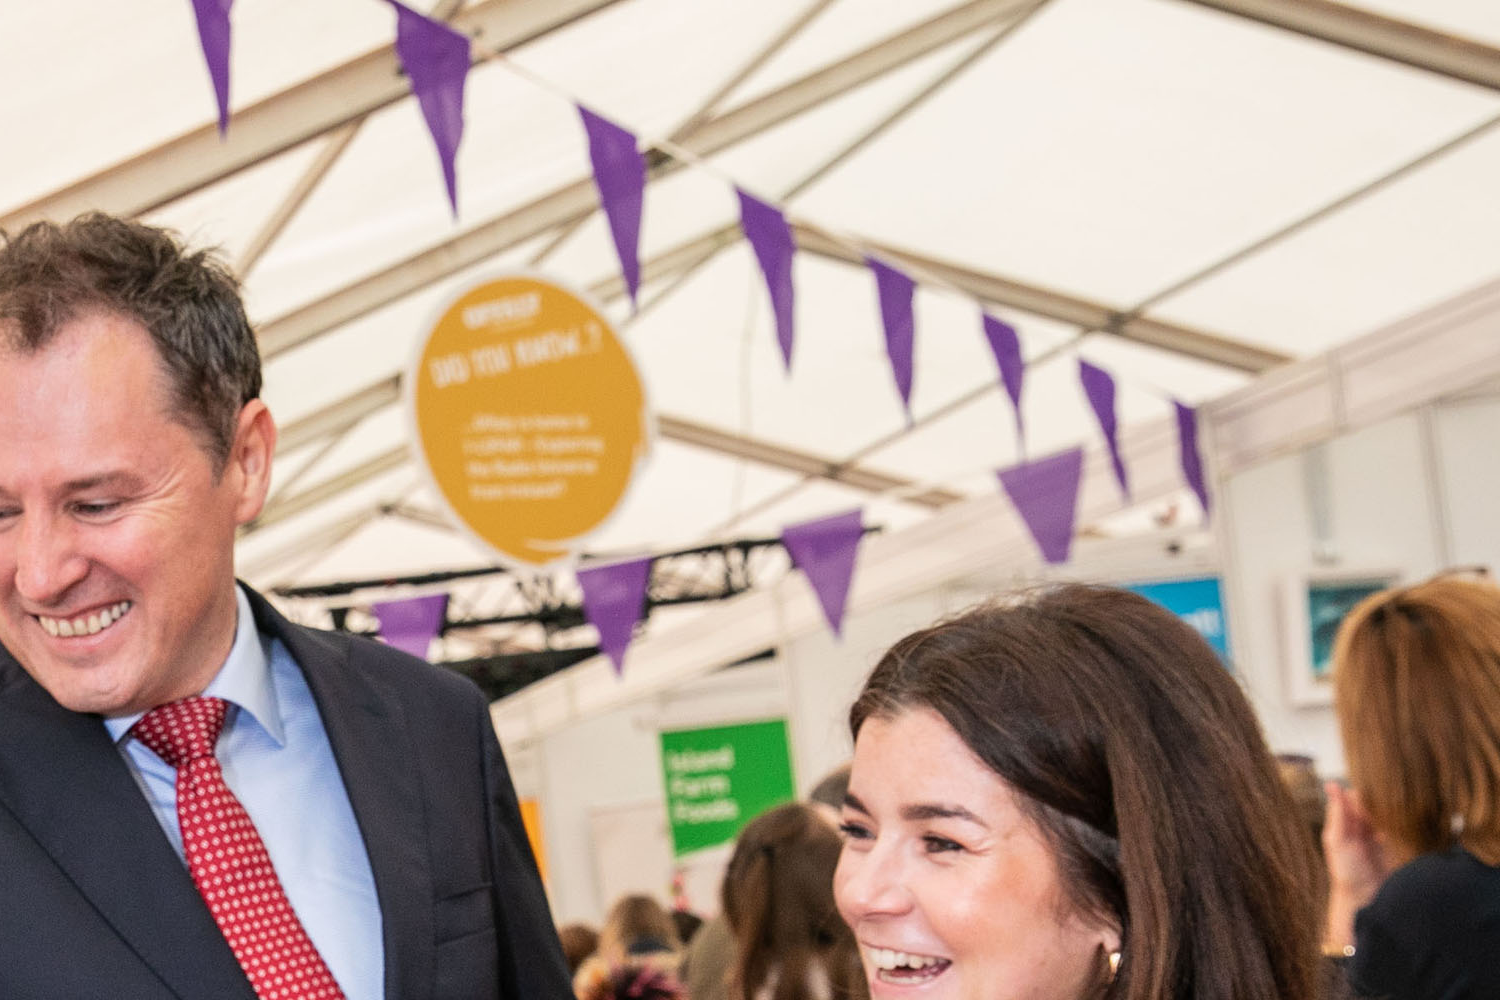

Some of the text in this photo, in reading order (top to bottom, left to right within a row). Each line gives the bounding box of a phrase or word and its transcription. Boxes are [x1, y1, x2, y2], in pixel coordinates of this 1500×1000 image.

[430, 353, 470, 388] DID
[471, 343, 511, 376] YOU
[670, 775, 730, 797] Farm
[673, 799, 738, 823] Foods
